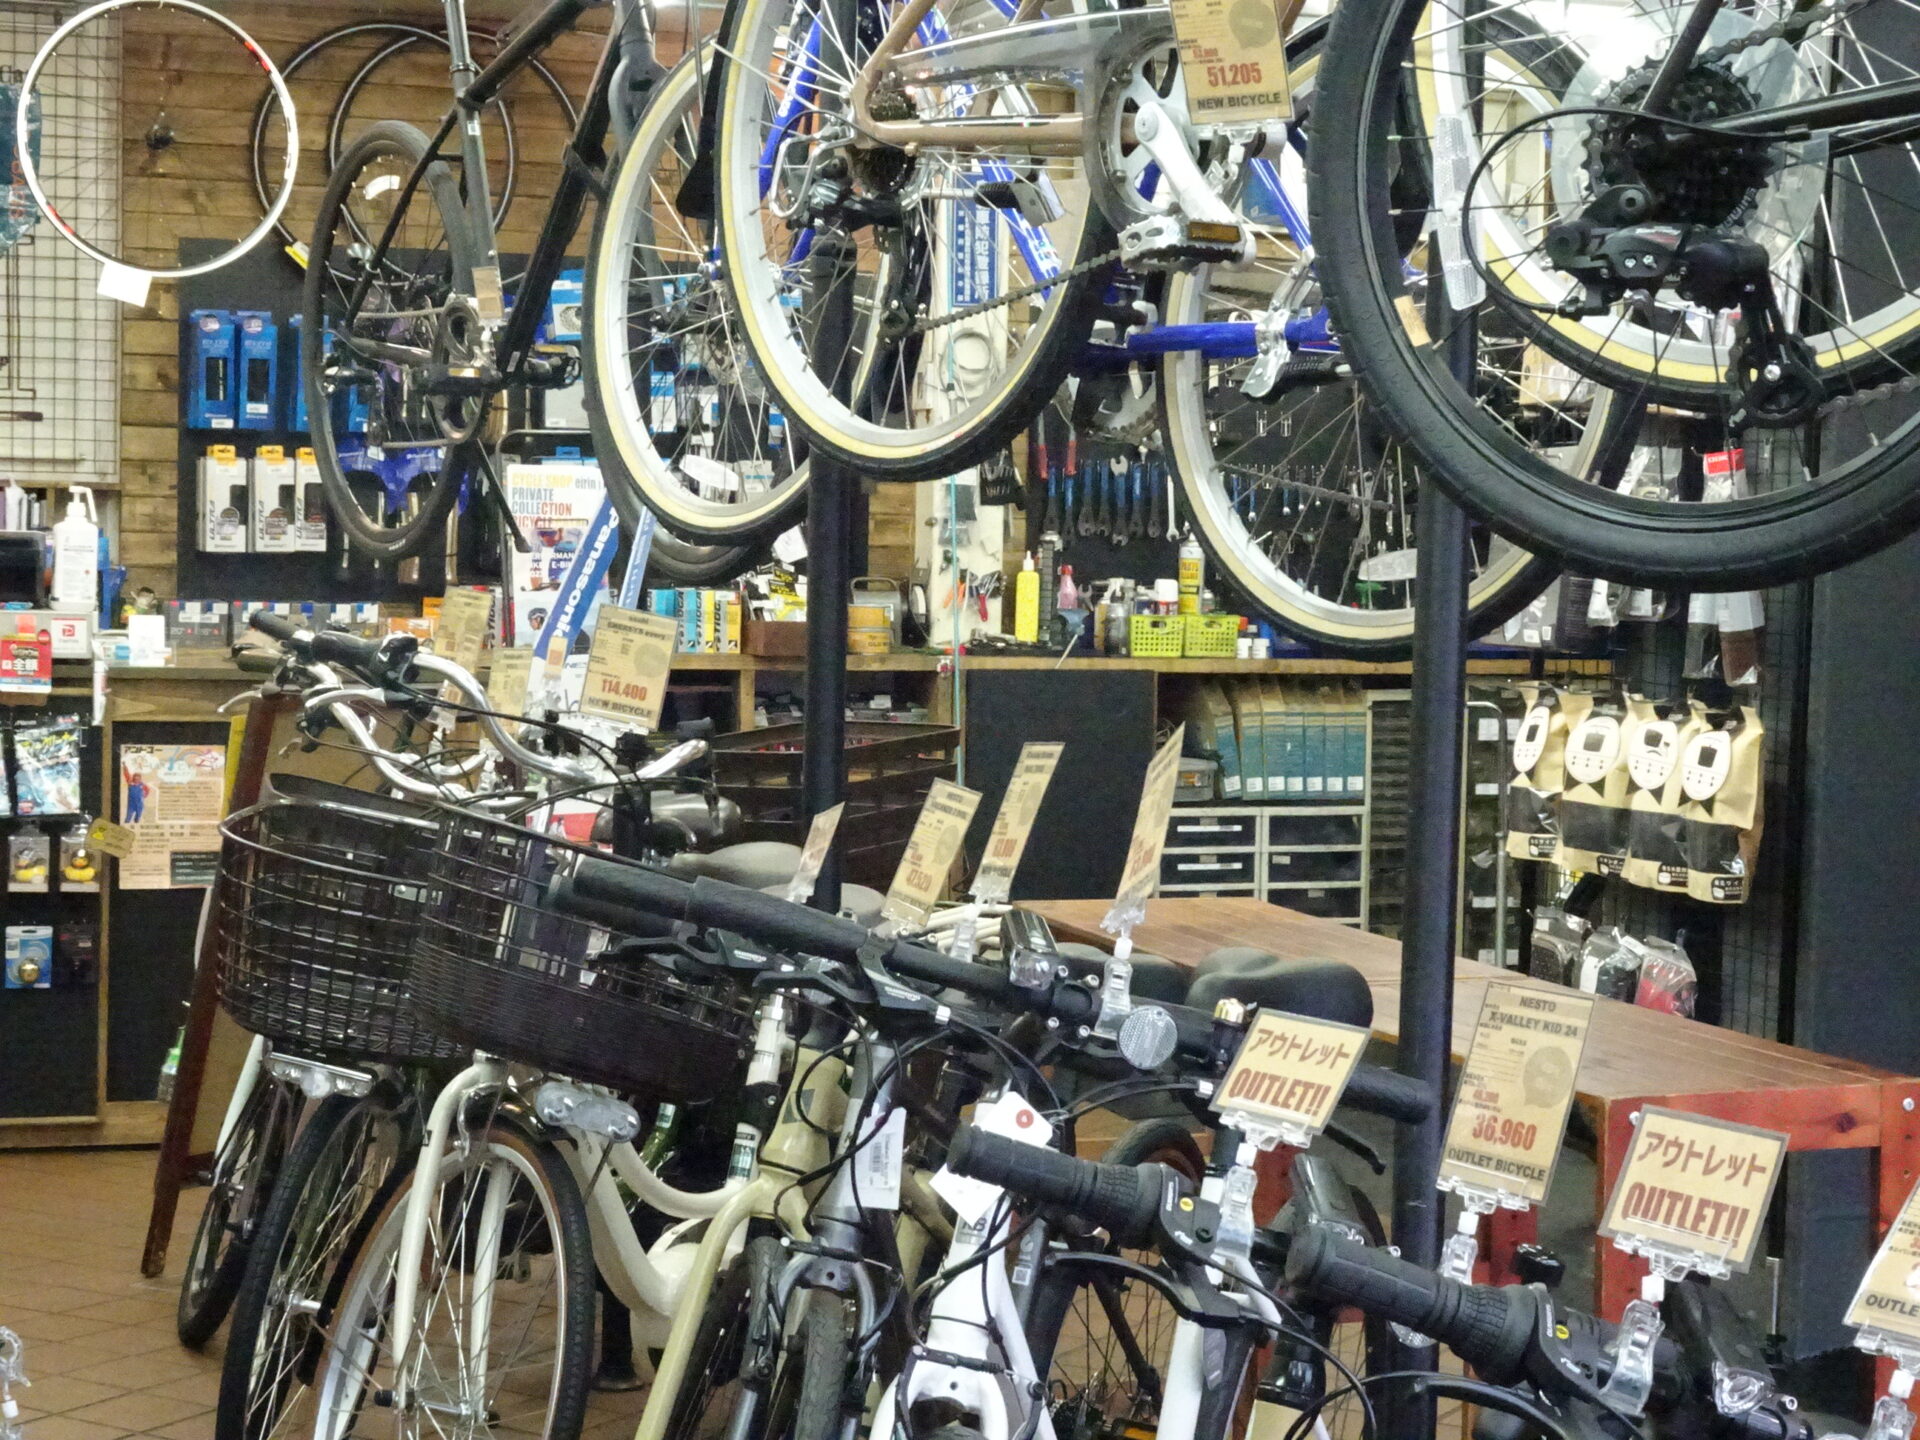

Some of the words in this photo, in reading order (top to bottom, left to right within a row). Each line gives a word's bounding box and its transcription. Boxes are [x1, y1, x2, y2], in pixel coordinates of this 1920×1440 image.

[1207, 62, 1262, 87] 51,205
[1197, 97, 1227, 110] NEW
[1229, 92, 1282, 106] BICYCLE
[512, 473, 541, 488] CYCLE
[546, 474, 573, 489] SHOP
[512, 488, 554, 502] PRIVATE
[512, 501, 572, 516] COLLECTION
[552, 506, 620, 637] Panasonic
[601, 678, 648, 701] 114,400
[588, 696, 609, 709] NEW
[611, 701, 655, 717] BICYCLE
[1519, 996, 1556, 1013] NESTO
[1488, 1011, 1540, 1031] X-VALLEY
[1542, 1022, 1562, 1034] KID
[1564, 1025, 1578, 1037] 24
[1248, 1027, 1351, 1070] アウトレット
[1229, 1068, 1332, 1115] OUTLET!!
[1472, 1113, 1538, 1152] 36,960
[1448, 1147, 1493, 1169] OUTLET
[1494, 1159, 1547, 1182] BICYCLE
[1636, 1130, 1767, 1188] アウトレット
[1621, 1182, 1749, 1248] OUTLET!!
